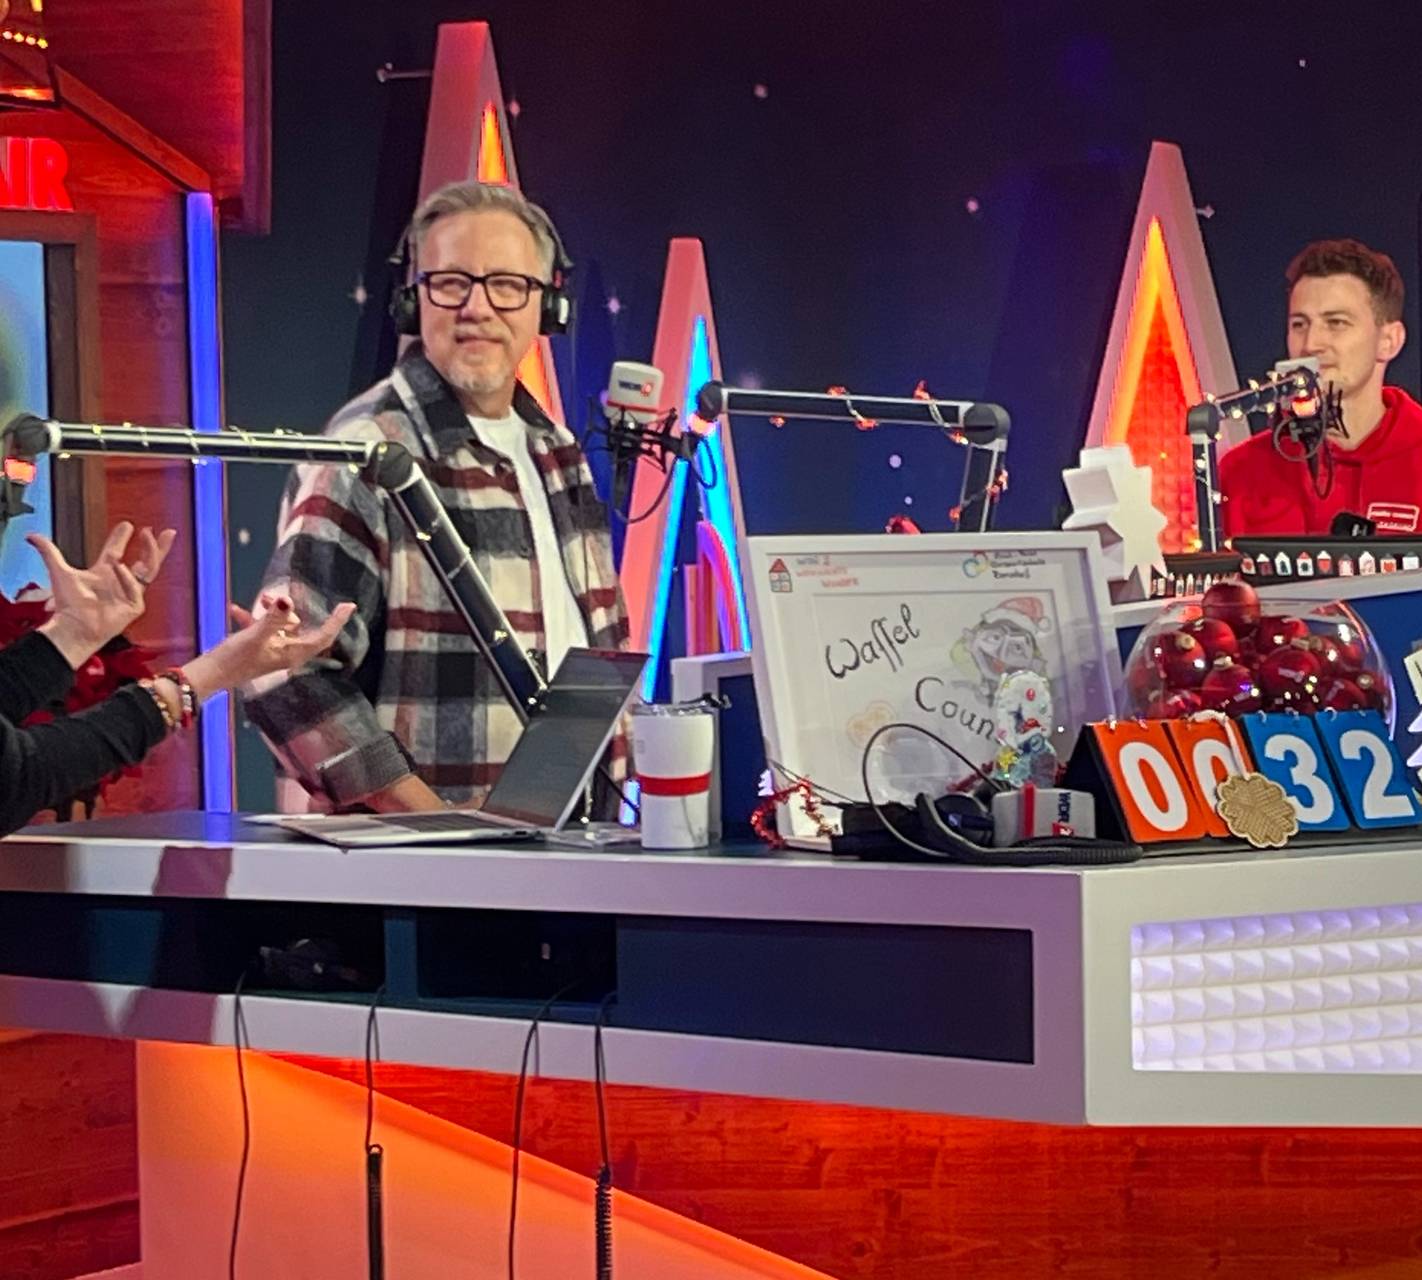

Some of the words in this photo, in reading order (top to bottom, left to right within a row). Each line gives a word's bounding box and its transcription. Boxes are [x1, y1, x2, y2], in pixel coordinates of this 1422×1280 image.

[0, 136, 74, 212] IR
[826, 603, 920, 679] Waffel
[915, 676, 1002, 743] Coun
